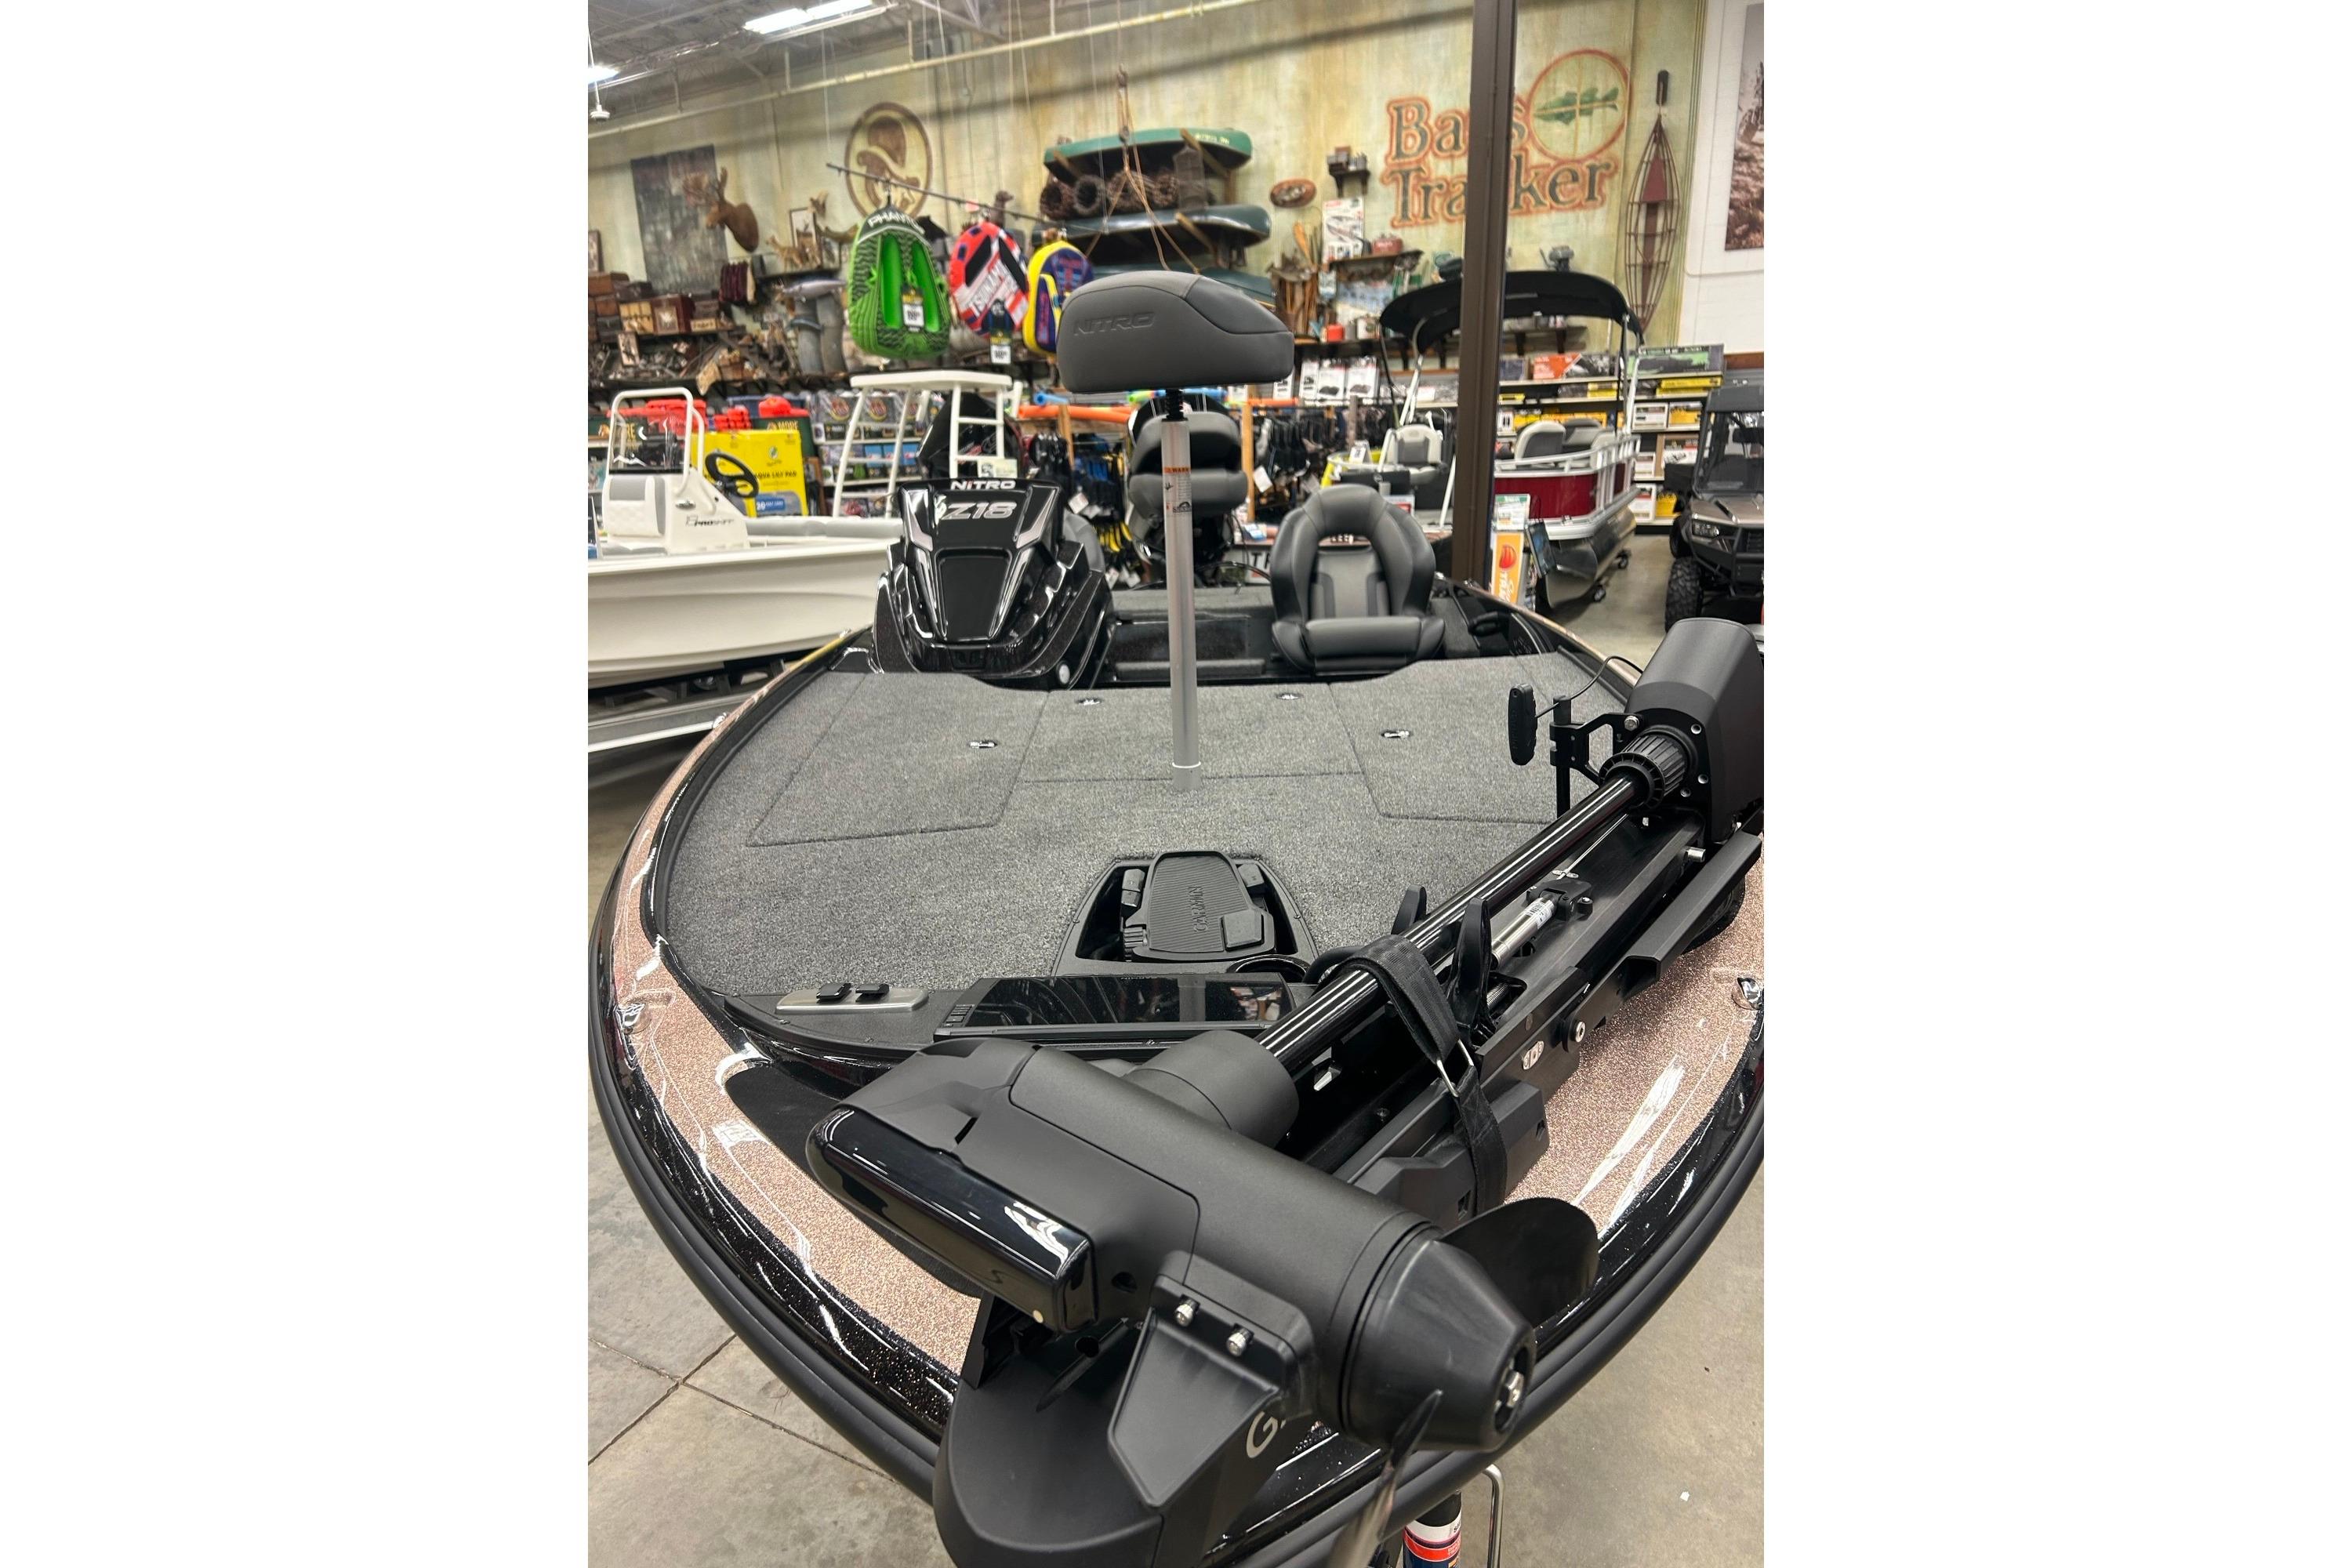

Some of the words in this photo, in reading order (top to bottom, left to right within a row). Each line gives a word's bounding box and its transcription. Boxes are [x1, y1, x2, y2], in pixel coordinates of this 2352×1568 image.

[1387, 95, 1532, 165] Bas
[1381, 147, 1618, 228] Traker
[1073, 311, 1156, 336] NITRO
[941, 501, 1018, 521] Z18
[1188, 886, 1209, 932] GARMIN
